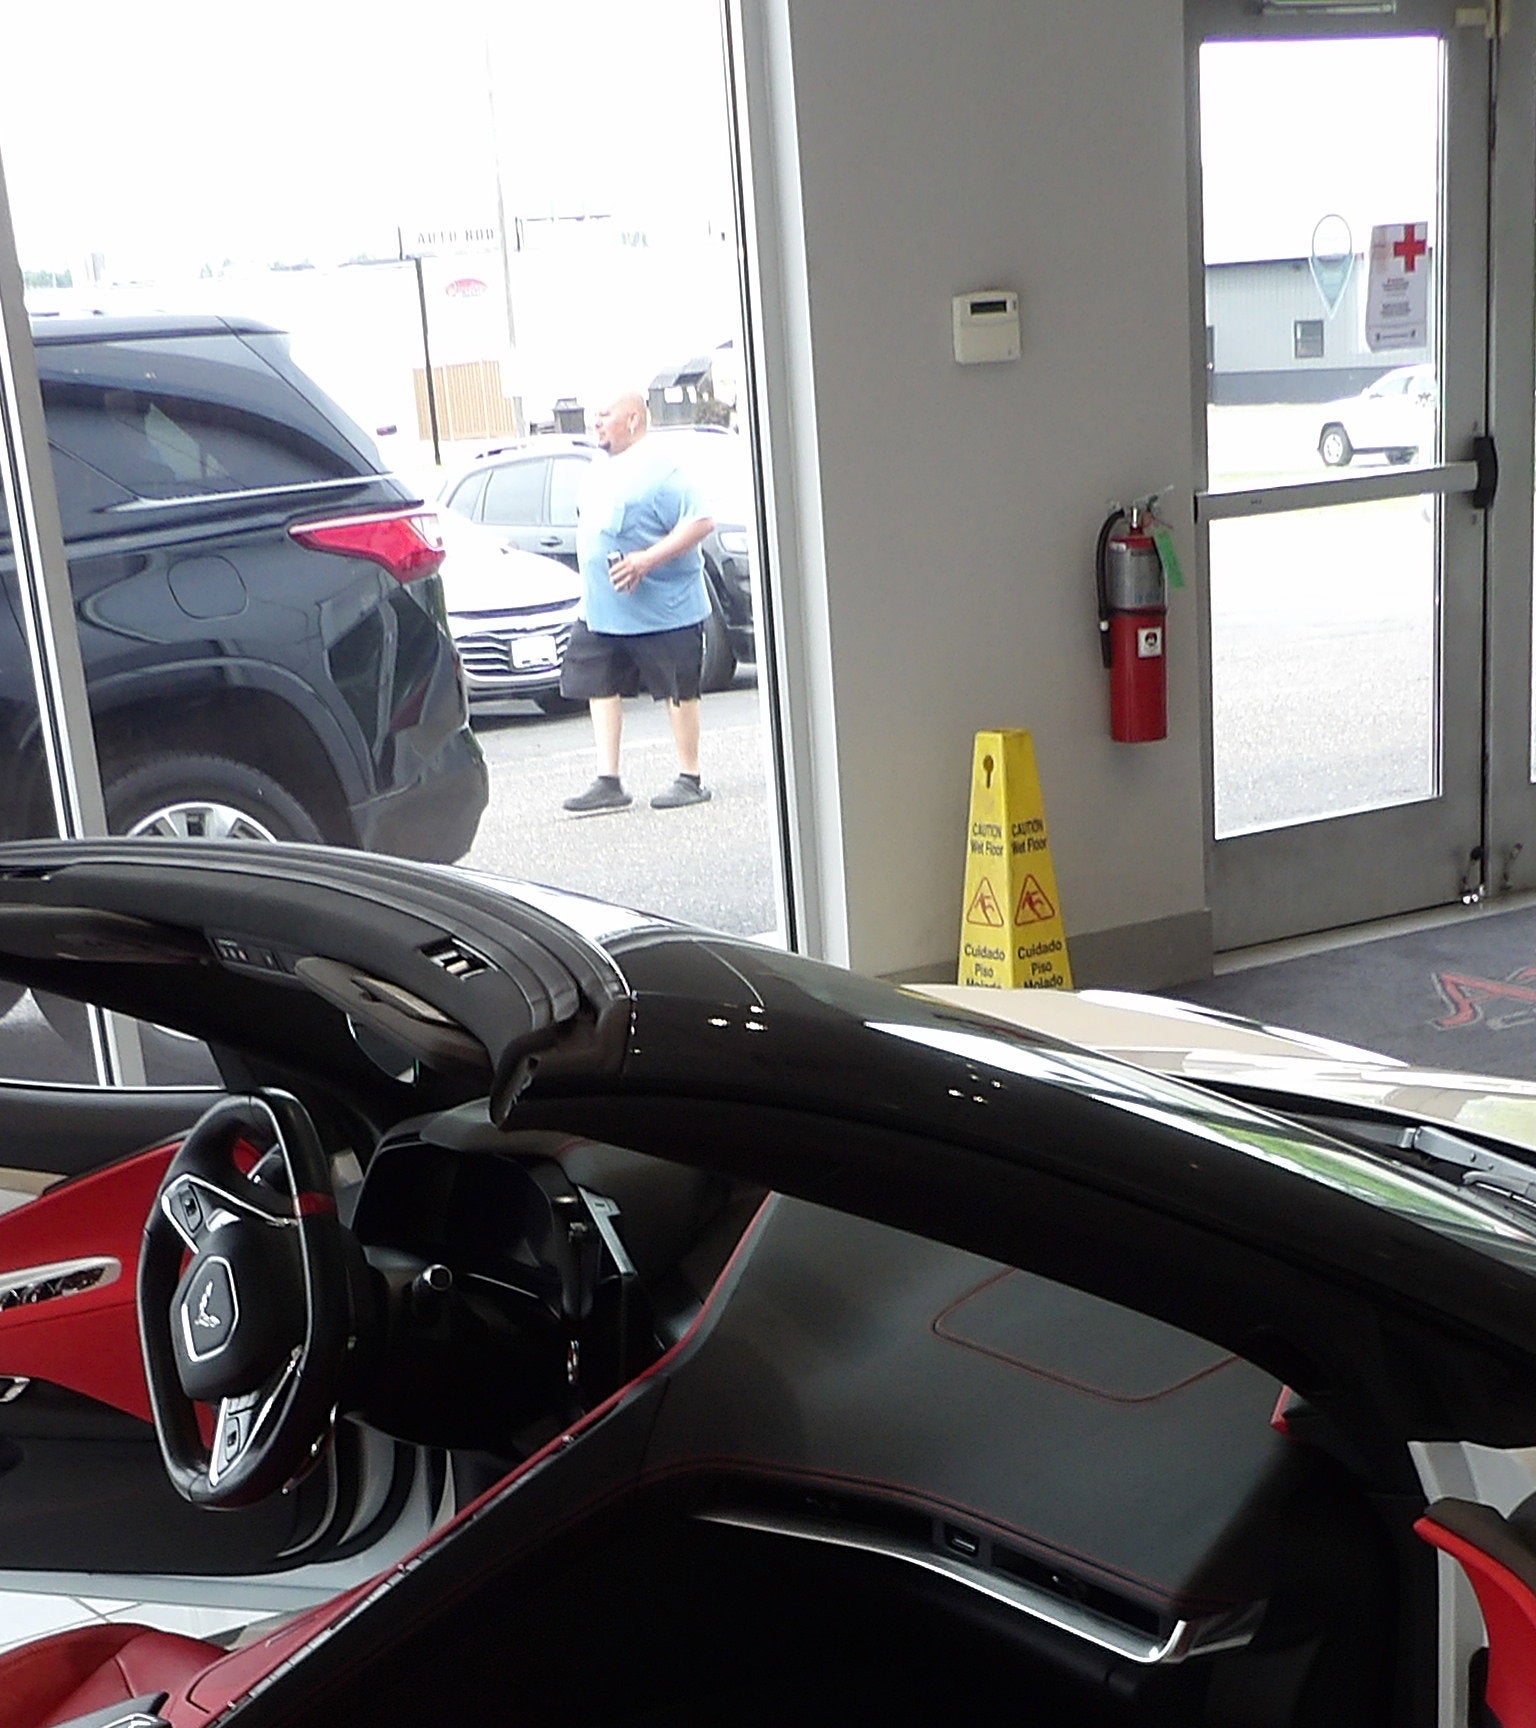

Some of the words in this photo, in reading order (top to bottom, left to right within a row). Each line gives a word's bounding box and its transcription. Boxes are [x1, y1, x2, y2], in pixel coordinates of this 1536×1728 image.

[418, 230, 457, 244] AUTO
[971, 821, 1003, 839] CAUTION
[1011, 818, 1045, 838] CAUTION
[970, 838, 984, 855] Wet
[985, 840, 1004, 857] Floor
[1011, 839, 1026, 855] Wet
[1026, 836, 1048, 853] Floor
[964, 942, 1006, 962] Cuidado
[1017, 939, 1063, 960] Cuidado
[974, 963, 994, 978] Piso
[1030, 960, 1053, 976] Piso
